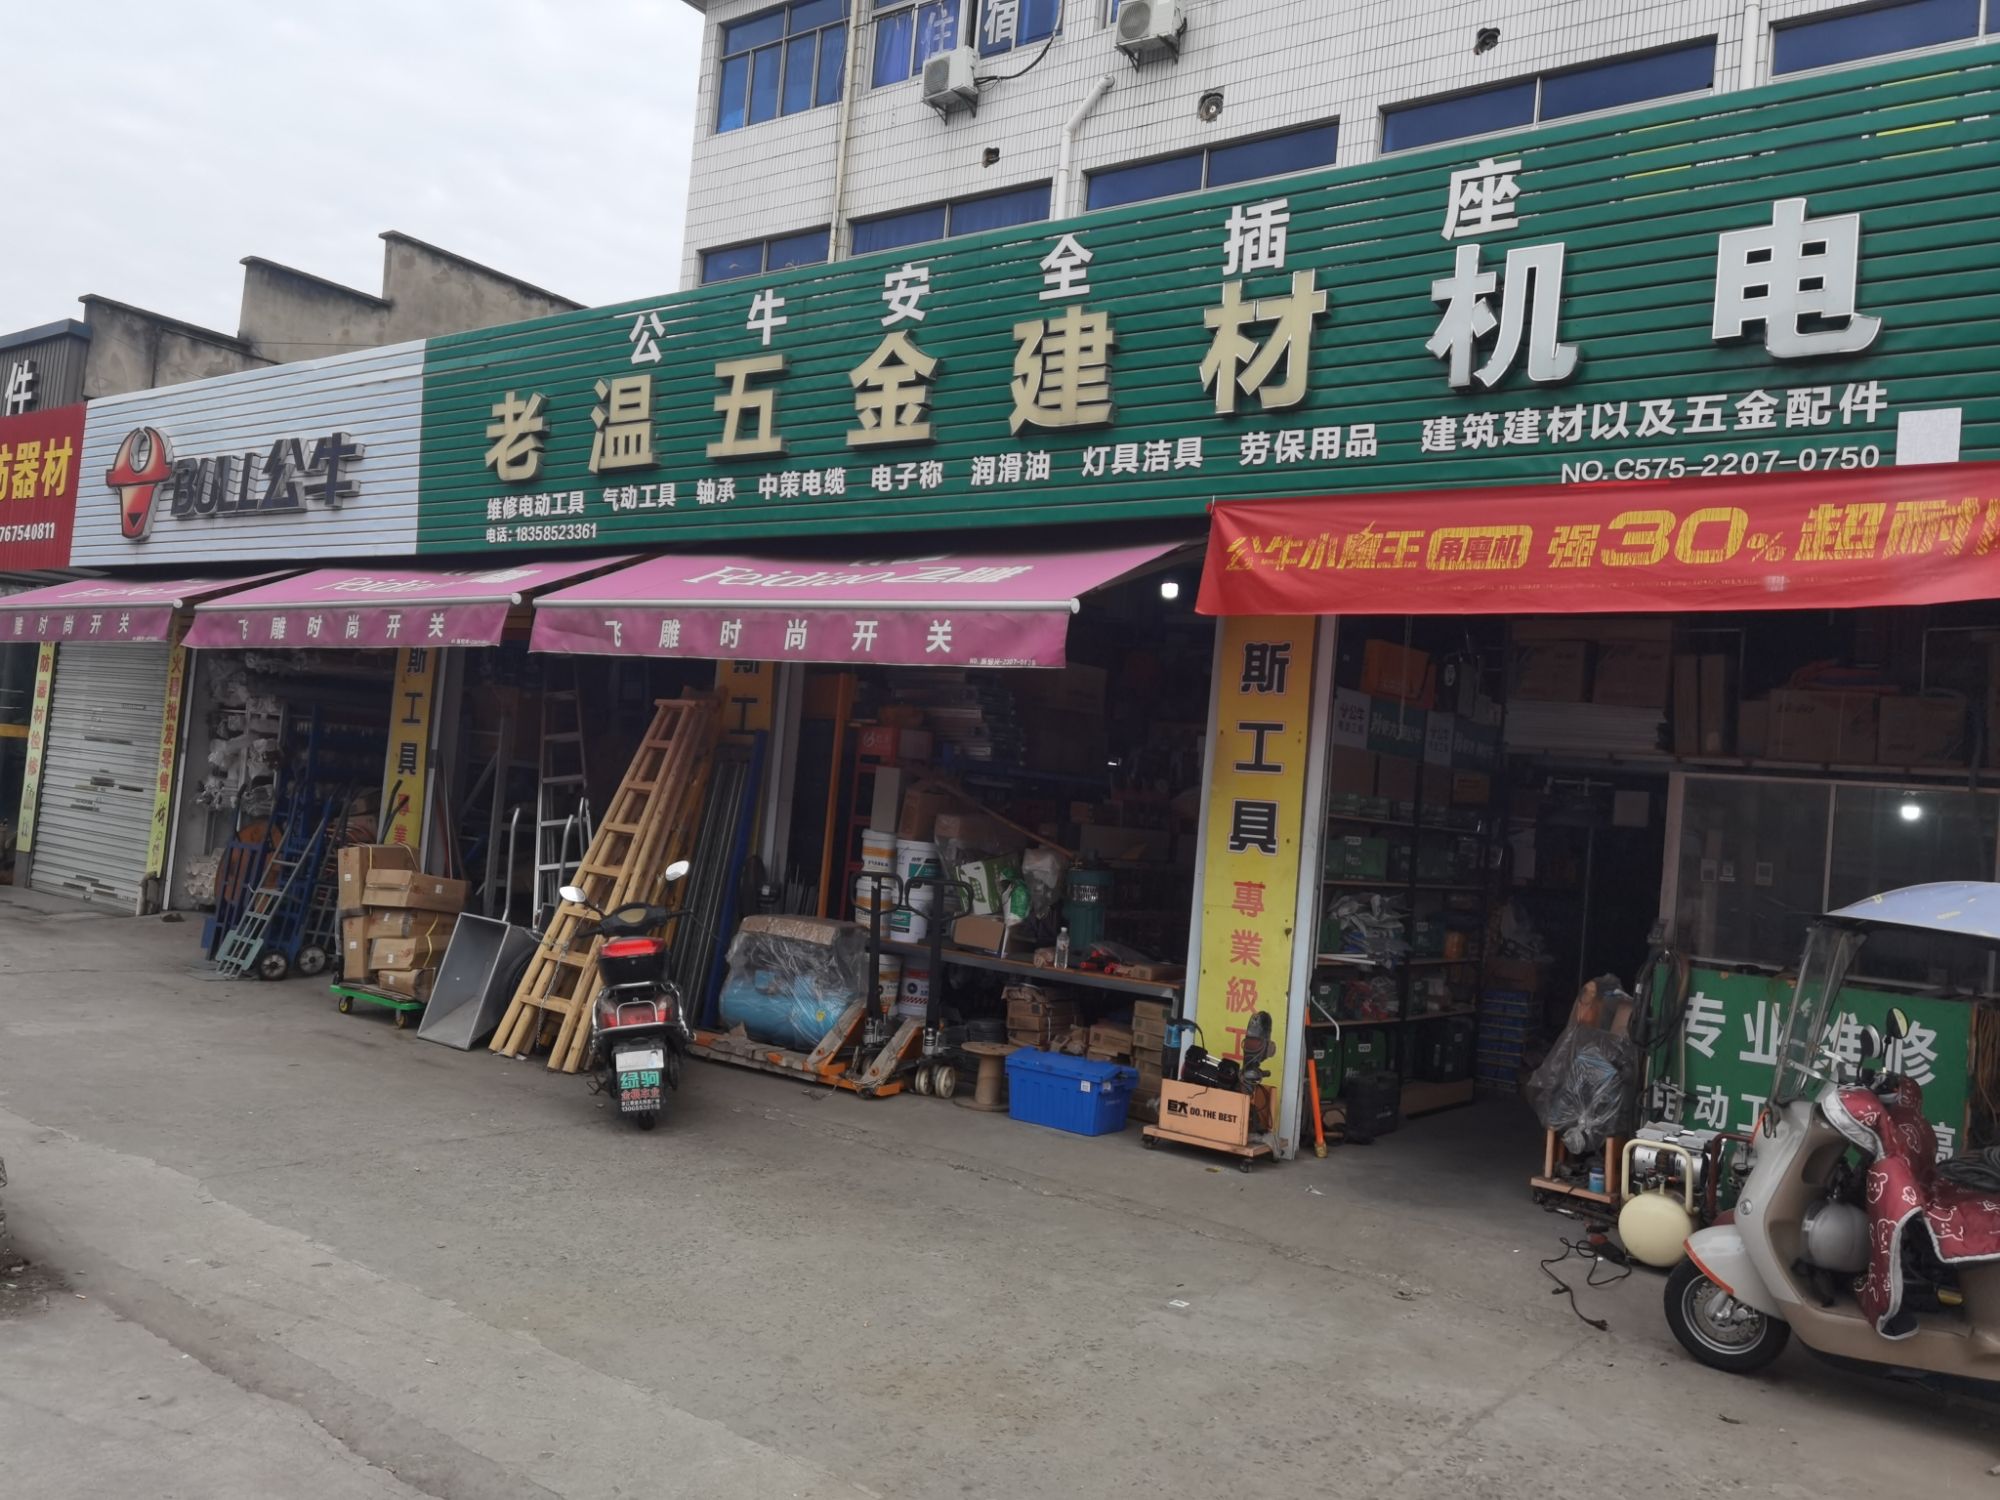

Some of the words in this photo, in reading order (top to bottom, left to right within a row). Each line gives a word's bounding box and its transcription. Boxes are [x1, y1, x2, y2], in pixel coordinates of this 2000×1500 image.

[921, 0, 1016, 57] 住宿
[628, 158, 1522, 366] 公牛安全插座
[4, 359, 34, 416] 件
[171, 452, 262, 519] BULL
[259, 432, 366, 513] 公牛
[486, 491, 585, 521] 维修电动工具
[603, 482, 677, 513] 气动工具
[696, 477, 736, 505] 轴承
[758, 467, 846, 500] 中策电缆
[871, 460, 944, 493] 电子称
[971, 449, 1051, 486] 润滑油
[1082, 438, 1203, 477] 灯具洁具
[1239, 424, 1378, 467] 劳保用品
[1421, 380, 1888, 453] 建筑建材以及五金配件
[1561, 445, 1880, 484] NO.C575-2207-0750
[238, 612, 444, 640] 飞雕时尚开关
[605, 618, 952, 655] 飞雕时尚开关
[1684, 991, 1938, 1088] 专业维修
[1218, 1112, 1238, 1124] BEST
